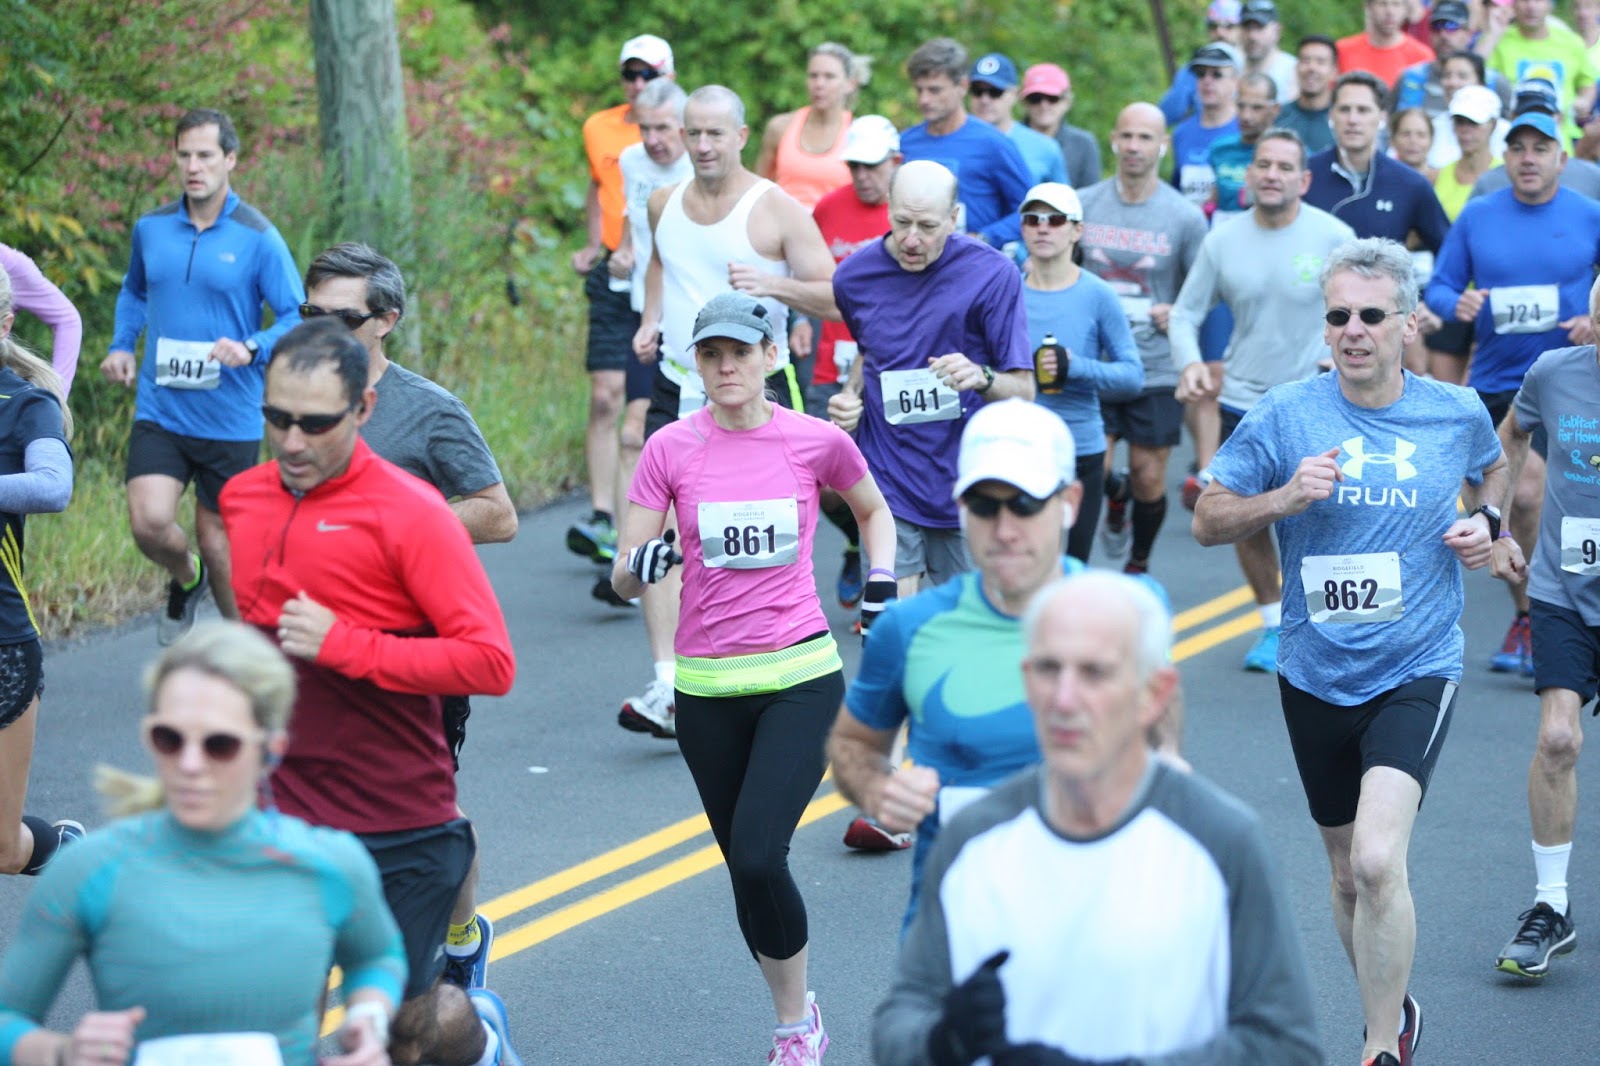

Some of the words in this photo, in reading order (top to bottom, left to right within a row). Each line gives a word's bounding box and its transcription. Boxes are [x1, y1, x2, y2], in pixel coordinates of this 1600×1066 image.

[1507, 304, 1540, 323] 724
[170, 357, 204, 379] 947
[899, 387, 939, 413] 641
[1559, 415, 1598, 429] Habitat
[1571, 449, 1587, 470] &
[1338, 486, 1417, 508] RUN
[723, 524, 775, 556] 861
[1582, 539, 1600, 565] 9
[1324, 578, 1379, 611] 862
